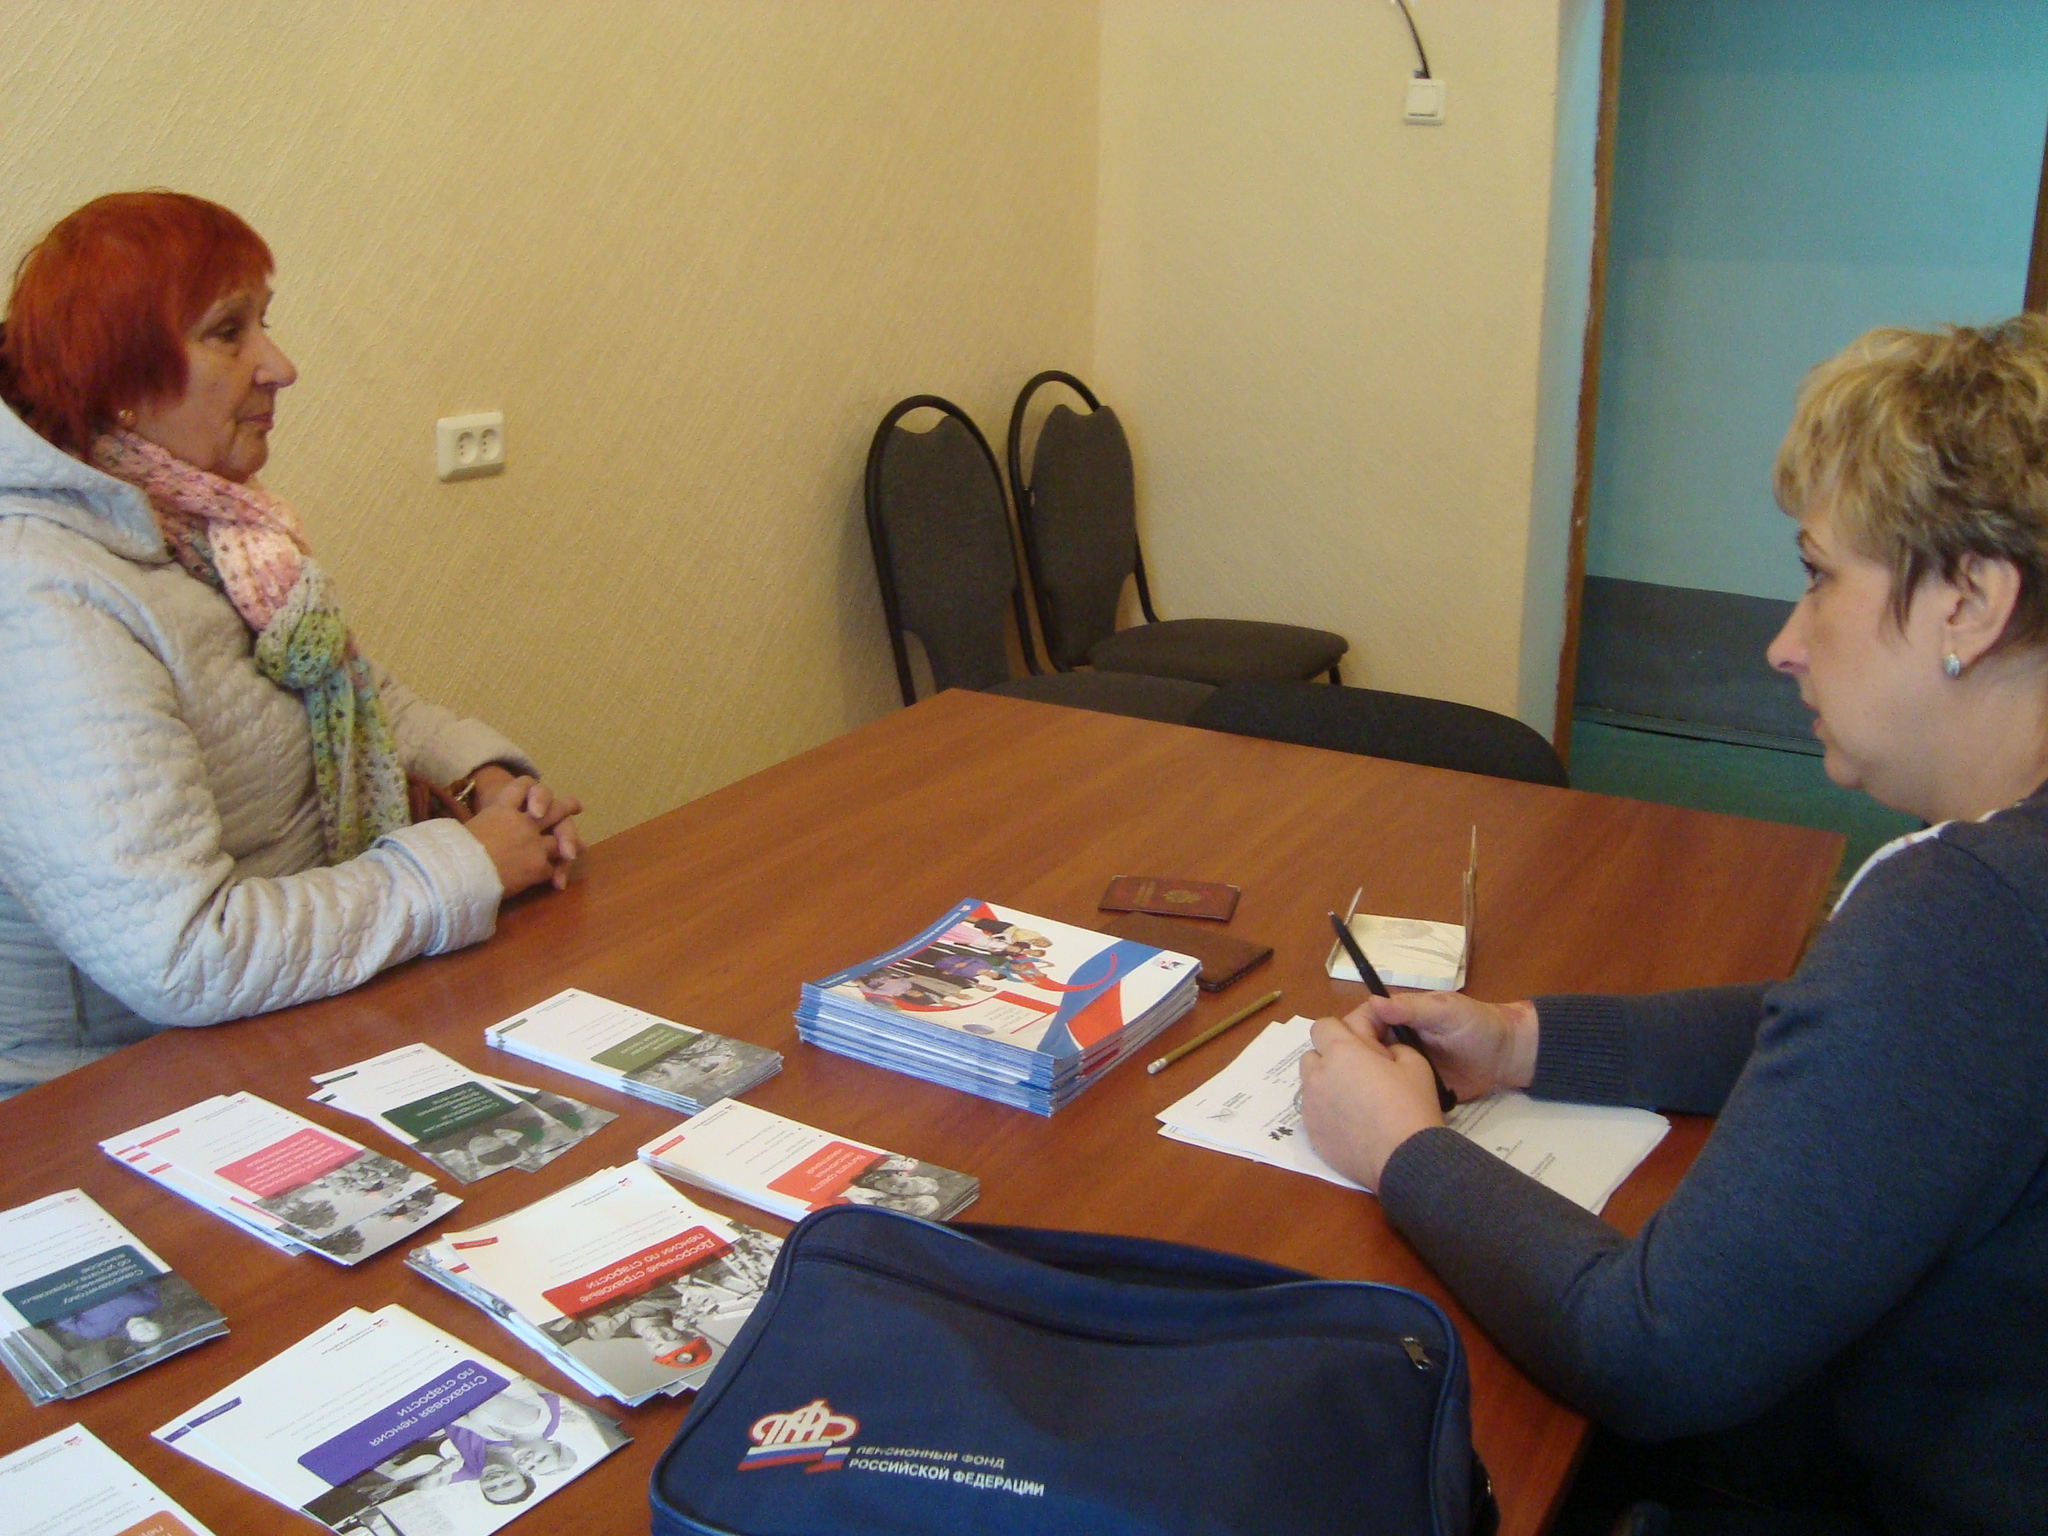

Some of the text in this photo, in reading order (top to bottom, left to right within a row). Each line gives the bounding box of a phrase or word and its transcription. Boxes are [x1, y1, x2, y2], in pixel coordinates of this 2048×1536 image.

[584, 1232, 705, 1290] пенсии по старости
[643, 1237, 716, 1276] Досрочные
[577, 1268, 646, 1305] страховые
[395, 1366, 476, 1418] по старости
[417, 1373, 488, 1419] Страховая
[367, 1414, 420, 1449] пенсия
[856, 1446, 1004, 1469] ПЕНСИОННЫЙ ФОНД
[849, 1458, 1044, 1496] РОССИЙСКОЙ ФЕДЕРАЦИИ
